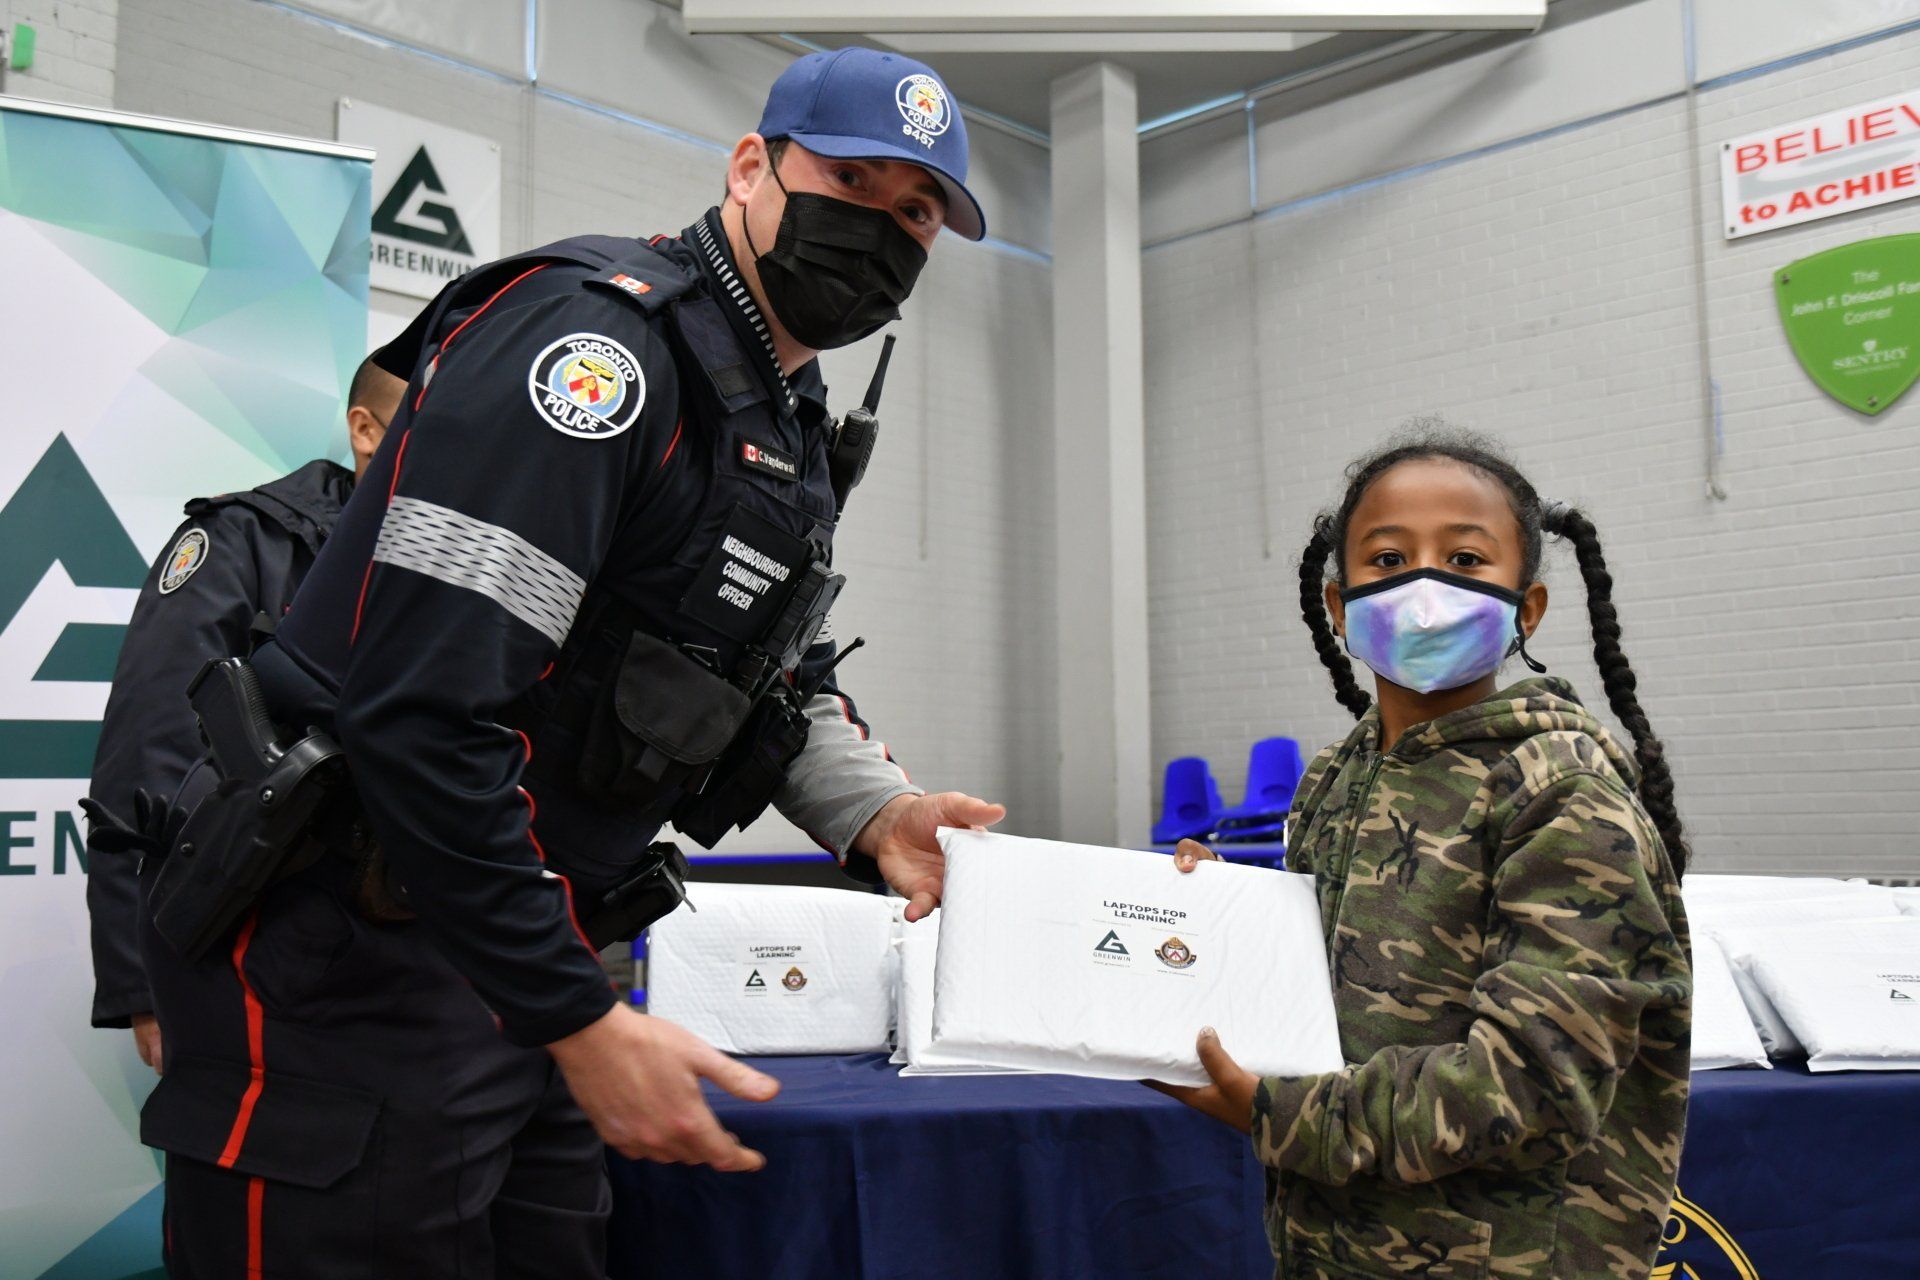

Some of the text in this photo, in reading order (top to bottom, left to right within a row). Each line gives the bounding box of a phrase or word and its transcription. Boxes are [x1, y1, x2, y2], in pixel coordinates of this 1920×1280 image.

[908, 110, 937, 130] POLICE
[902, 124, 935, 150] 9457
[1741, 162, 1920, 223] to ACHIE
[566, 340, 636, 382] TORONTO
[543, 392, 600, 432] POLICE
[721, 534, 790, 582] NEIGHBOURHOOD
[722, 560, 772, 596] COMMUNITY
[717, 583, 754, 611] OFFICER
[1103, 900, 1187, 919] LAPTOPS FOR
[1114, 910, 1176, 925] LEARNING
